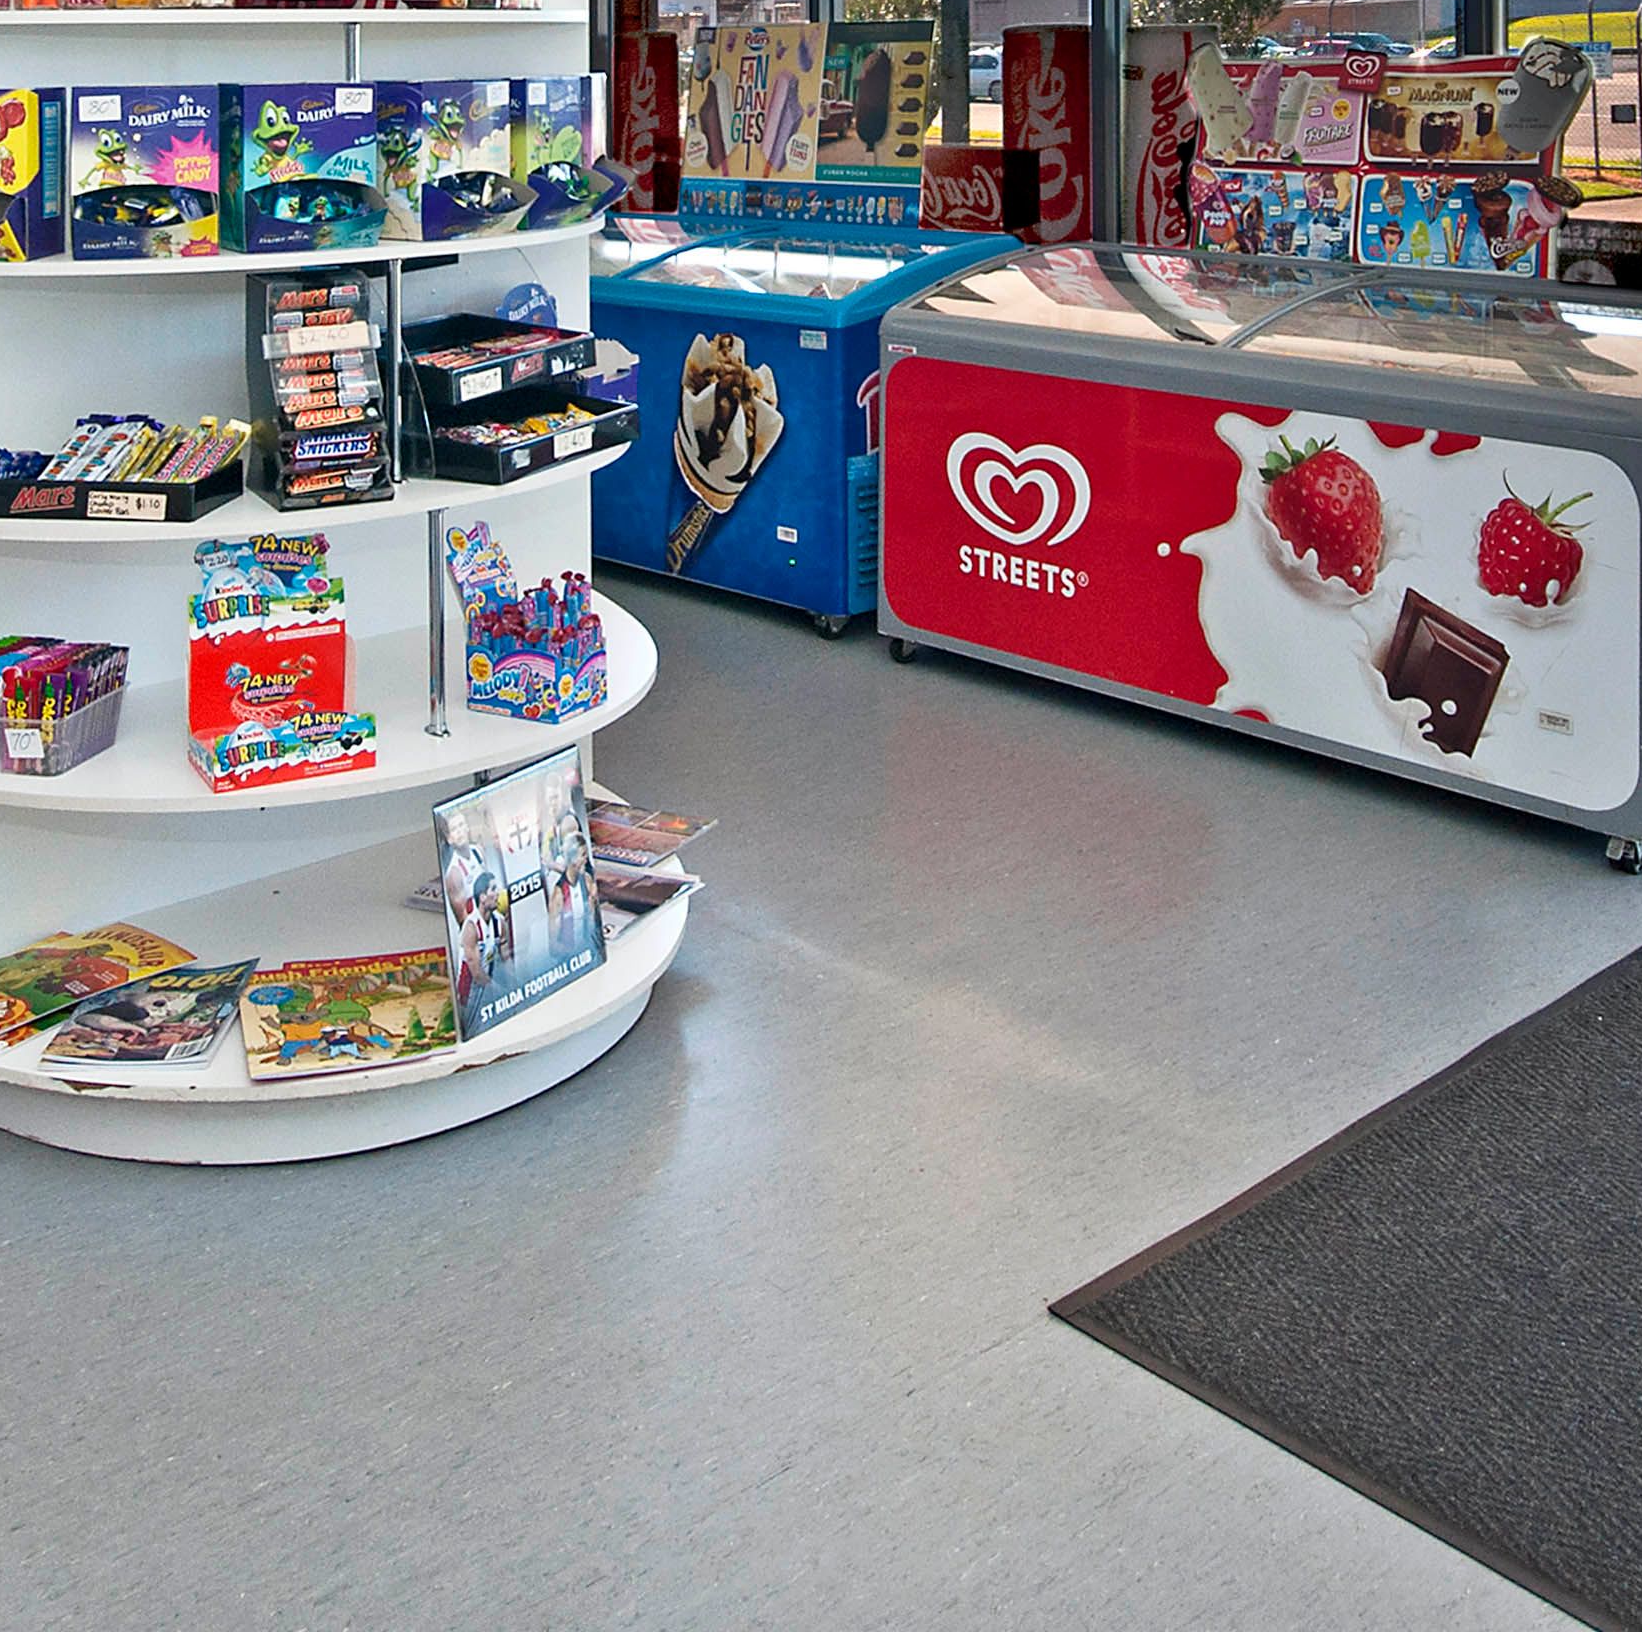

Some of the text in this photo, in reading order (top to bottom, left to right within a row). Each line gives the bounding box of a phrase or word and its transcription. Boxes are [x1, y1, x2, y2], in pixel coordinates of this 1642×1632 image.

[739, 55, 770, 90] FAN
[735, 85, 767, 112] DAN
[1497, 87, 1518, 96] NEW
[128, 111, 170, 127] DAIRY
[171, 104, 210, 120] MILK
[296, 106, 335, 123] DAIRY
[175, 168, 211, 184] CANDY
[333, 155, 371, 172] MILK
[297, 440, 369, 458] SNICKERS
[10, 486, 76, 514] Mars
[252, 534, 319, 556] 74 NEW
[959, 544, 1076, 599] STREETS
[193, 594, 271, 630] SURPRISE
[240, 674, 299, 692] 74 NEW
[471, 670, 521, 698] MELODY
[290, 712, 347, 731] 74 NEW
[216, 740, 286, 772] SURPRISE
[509, 874, 542, 902] 2015
[480, 949, 593, 1024] ST KILDA FOOTBALL CLUB
